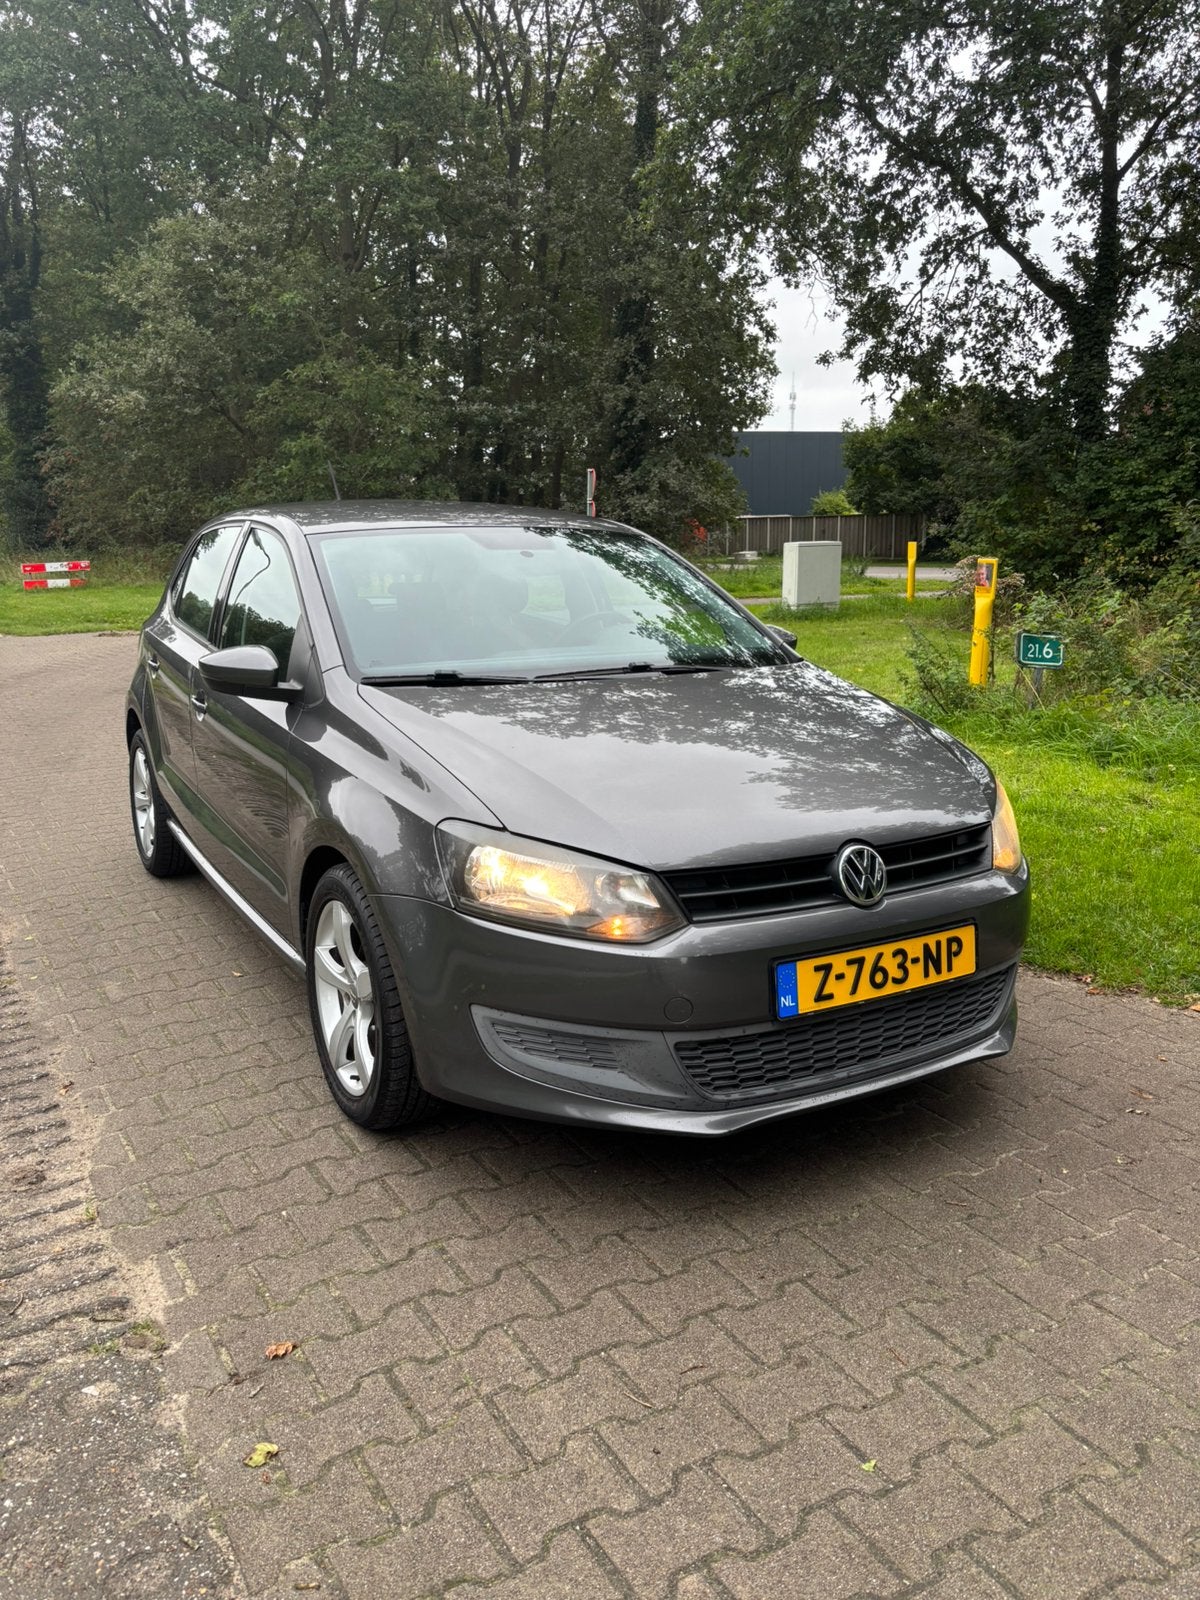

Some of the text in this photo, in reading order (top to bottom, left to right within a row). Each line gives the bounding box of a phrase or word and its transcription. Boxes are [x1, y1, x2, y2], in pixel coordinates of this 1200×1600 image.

[1027, 642, 1053, 659] 21.6
[813, 935, 964, 1003] Z-763-NP
[780, 994, 796, 1008] NL
